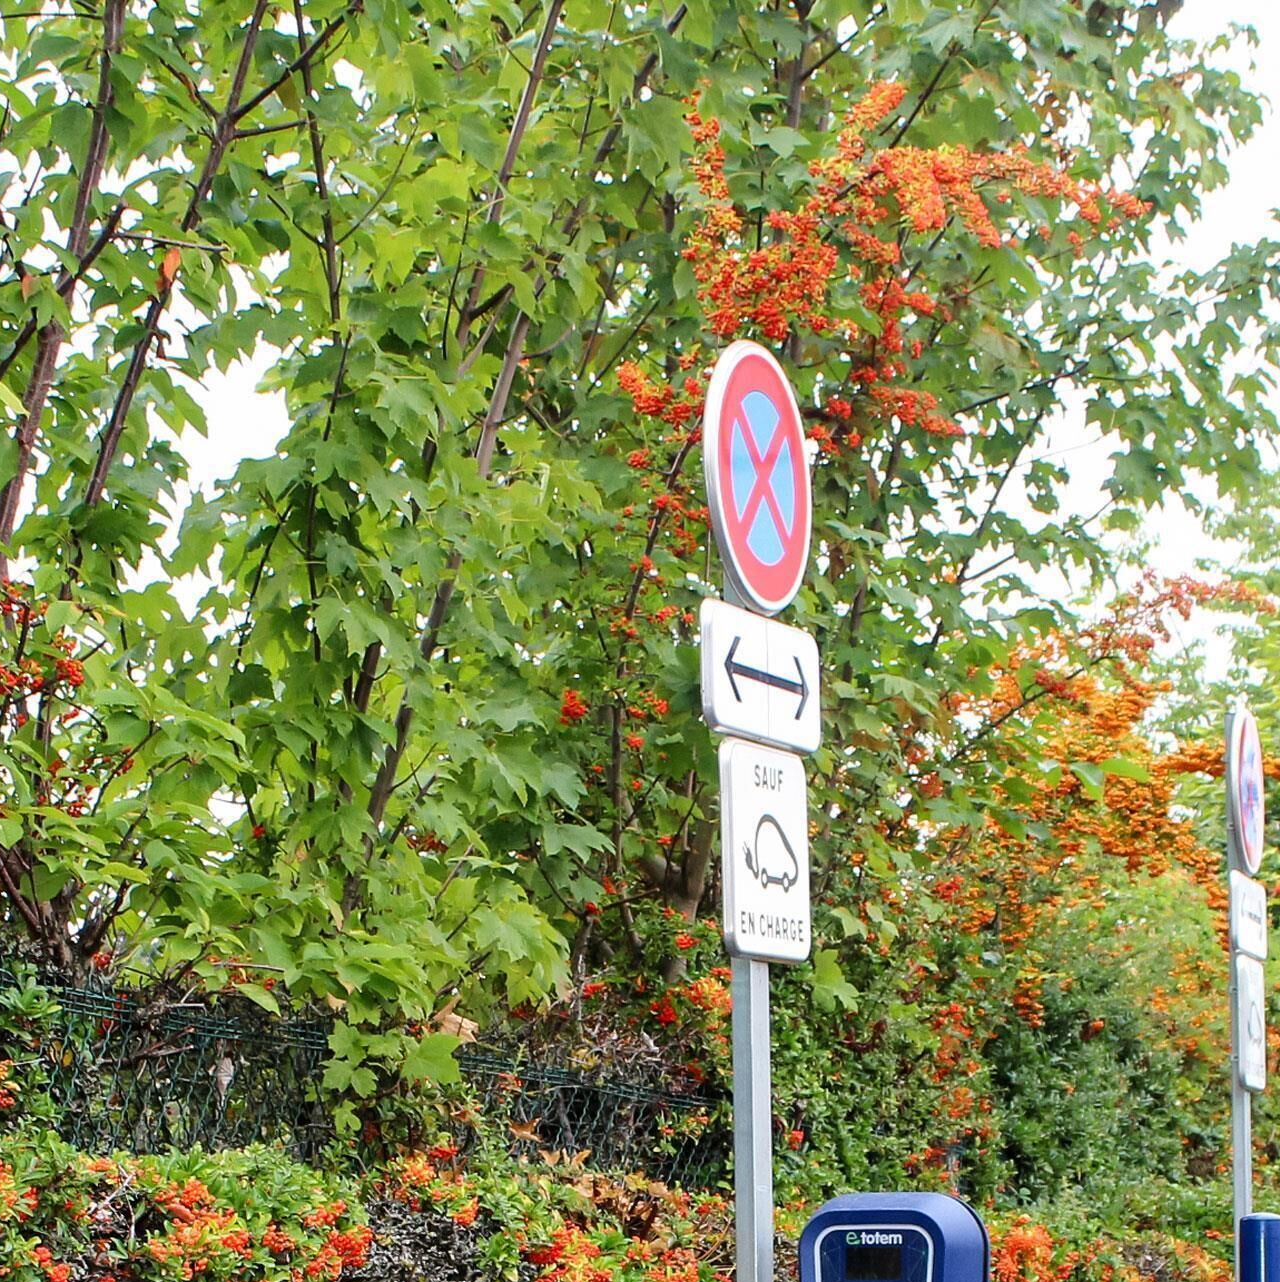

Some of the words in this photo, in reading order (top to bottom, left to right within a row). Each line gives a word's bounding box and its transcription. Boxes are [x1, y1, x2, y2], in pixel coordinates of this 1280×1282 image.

[754, 764, 784, 792] SAUF
[740, 911, 755, 936] EN
[759, 914, 805, 942] CHARGE
